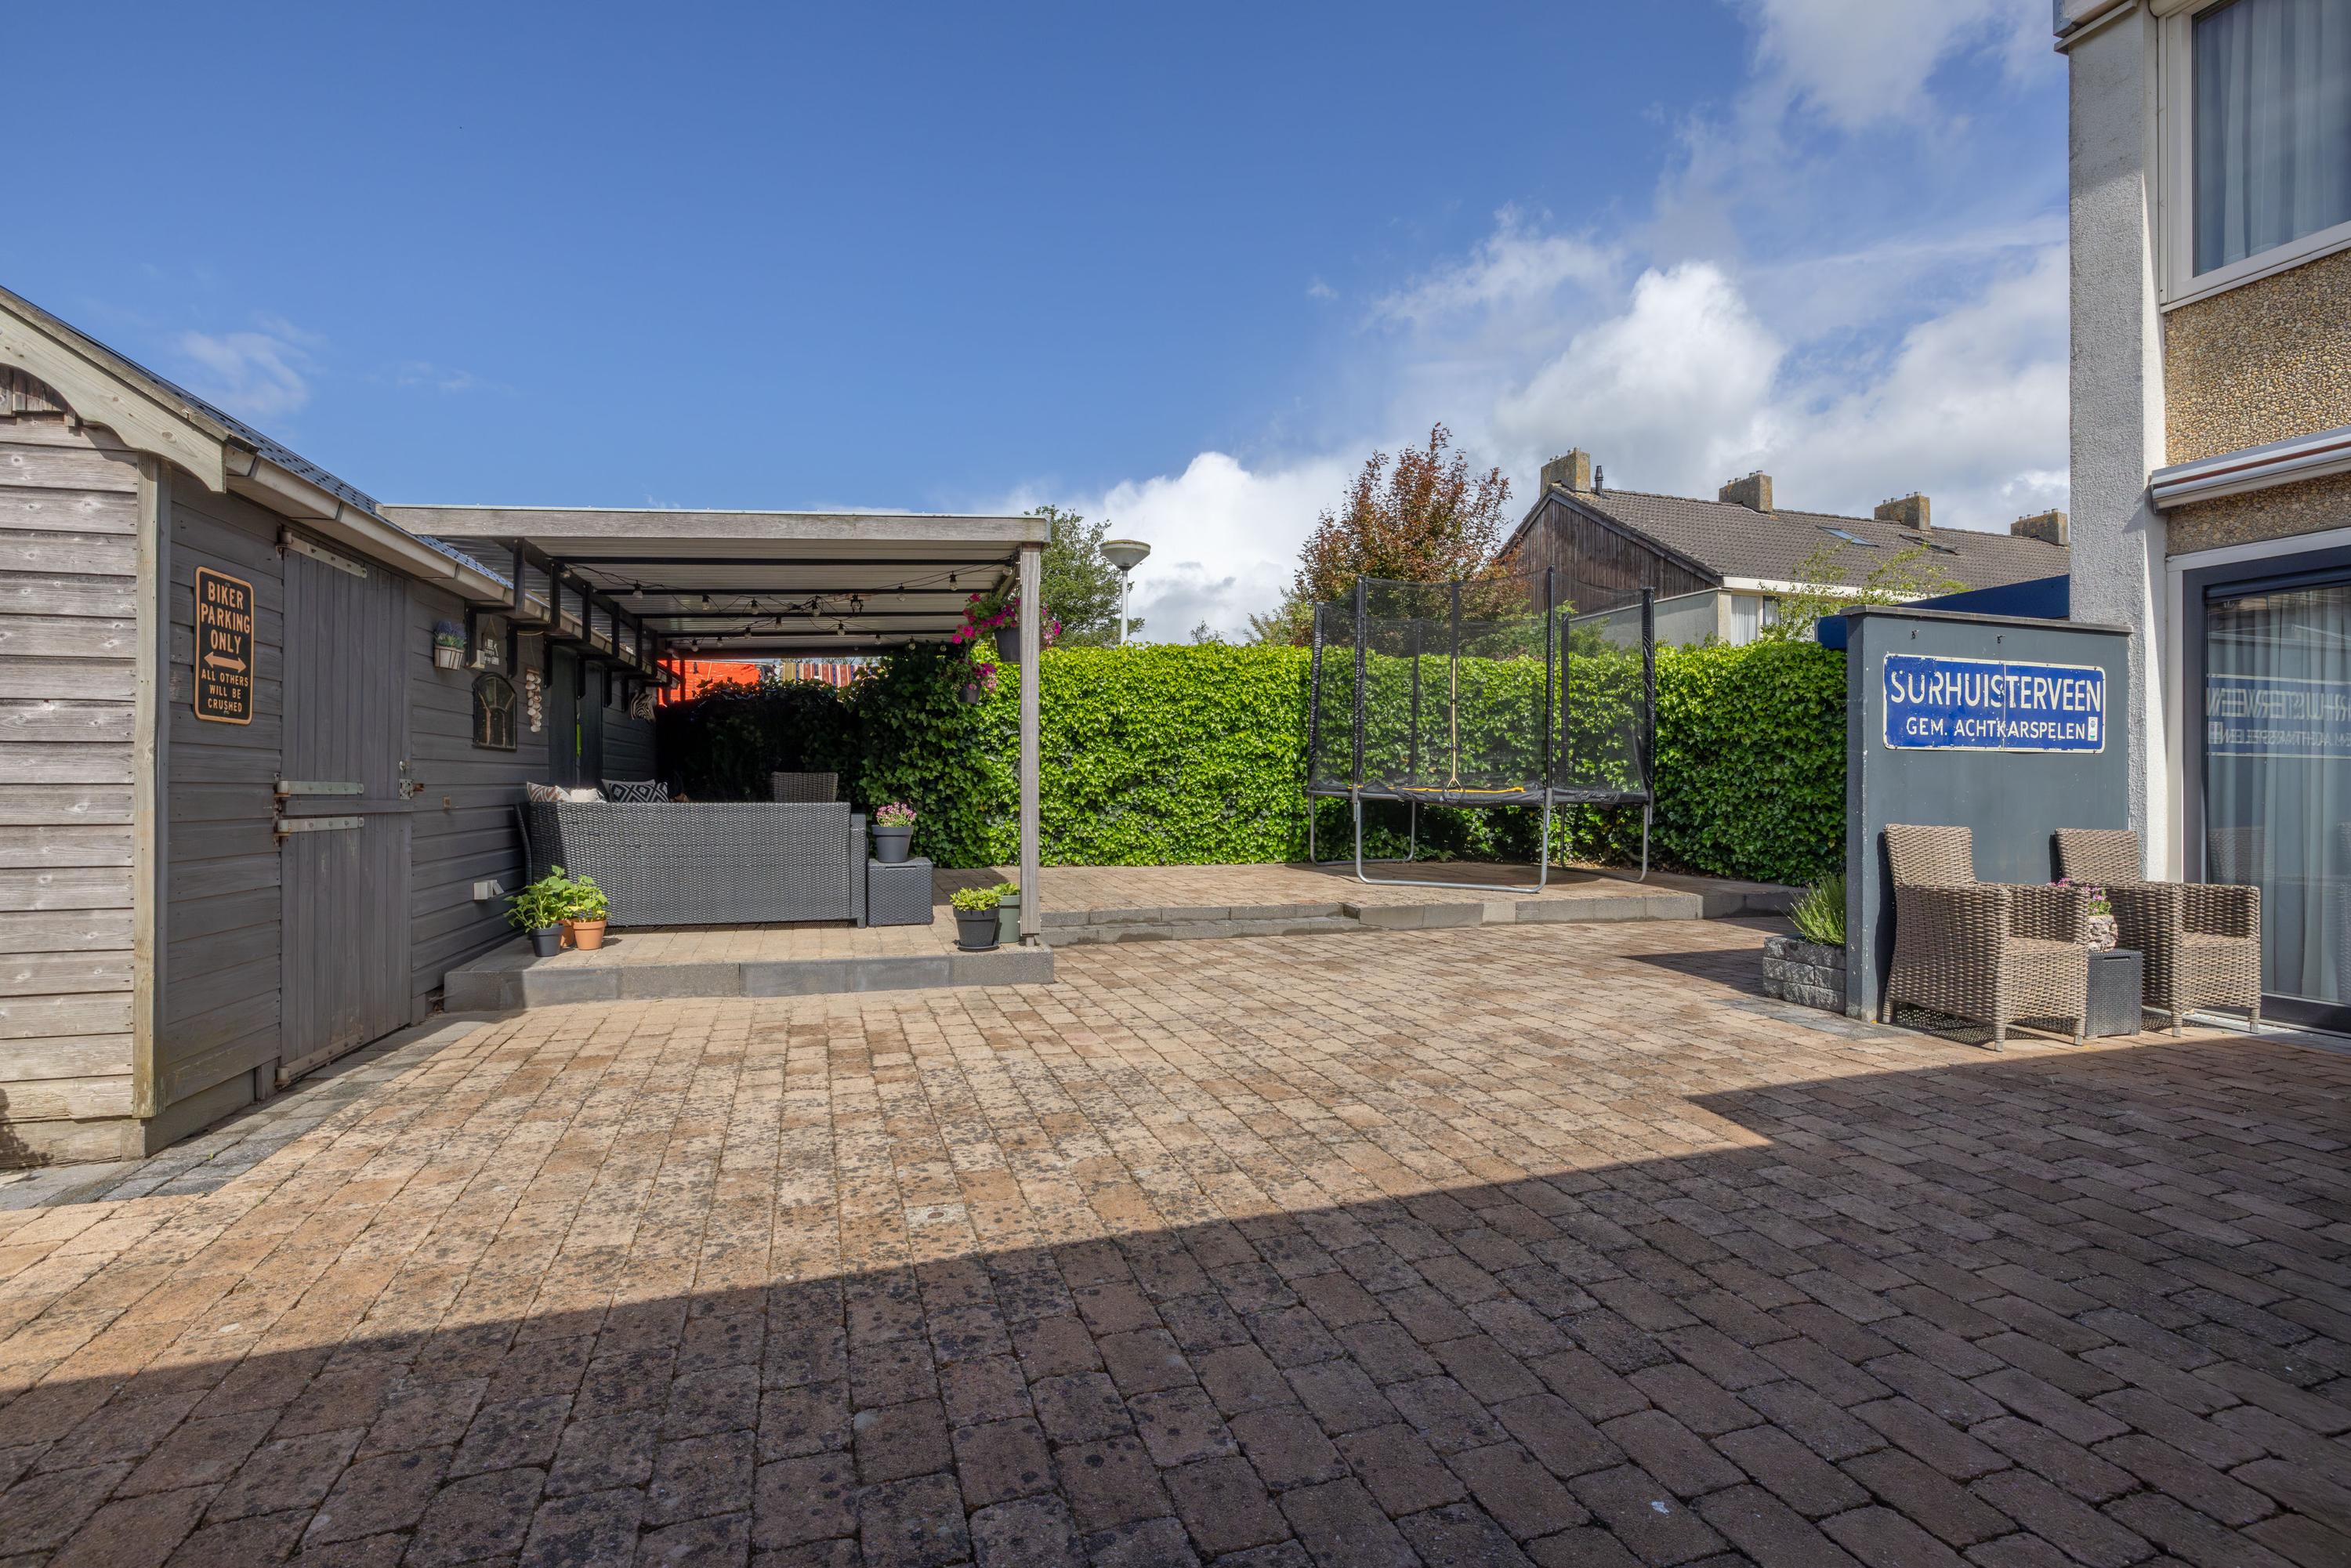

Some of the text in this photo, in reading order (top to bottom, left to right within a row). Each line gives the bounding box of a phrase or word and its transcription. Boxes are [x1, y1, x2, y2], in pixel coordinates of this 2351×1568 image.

[208, 581, 244, 610] BIKER
[201, 603, 251, 634] PARKING
[210, 629, 241, 654] ONLY
[201, 668, 248, 687] ALL OTHERS
[208, 685, 241, 699] WILL BE
[1890, 670, 2101, 712] SURHUISTERVEEN
[207, 698, 243, 713] CRUSHED
[1906, 716, 2085, 740] GEM. ACHTKARSPELEN
